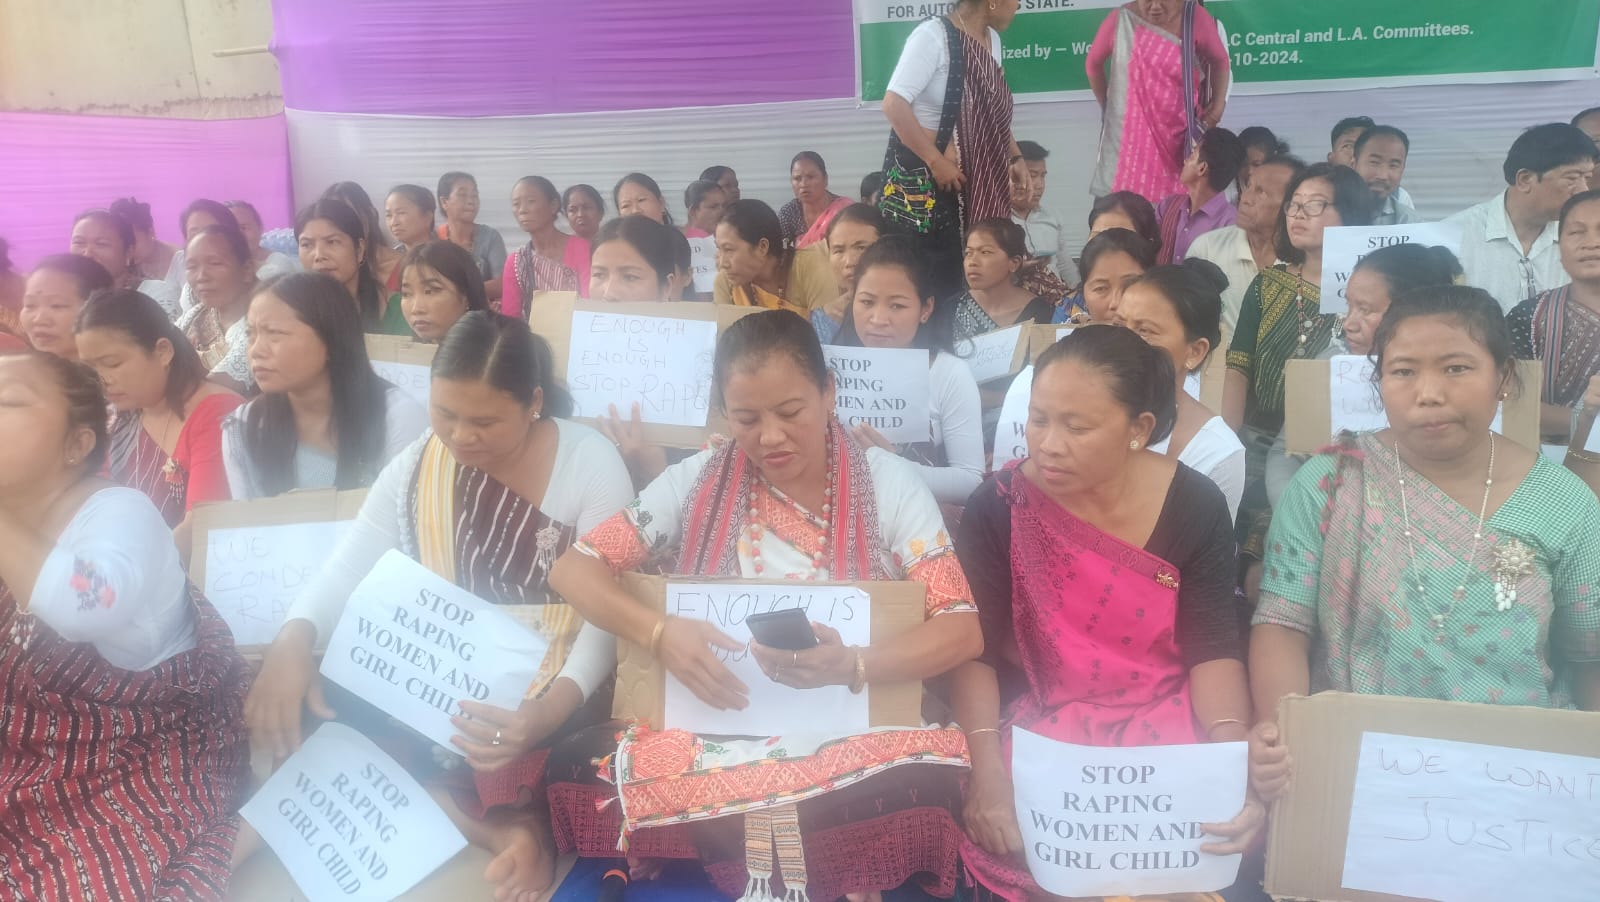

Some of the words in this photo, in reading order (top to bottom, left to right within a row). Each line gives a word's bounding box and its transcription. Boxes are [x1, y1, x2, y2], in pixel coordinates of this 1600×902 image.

[887, 4, 915, 18] FOR
[1245, 29, 1300, 46] Central
[1304, 27, 1333, 43] and
[1337, 26, 1368, 41] L.A.
[1373, 22, 1474, 40] Committees.
[1035, 43, 1051, 60] by
[1367, 235, 1410, 248] STOP
[590, 315, 686, 343] ENOUGH
[627, 336, 649, 352] IS
[582, 350, 666, 369] ENOUGH
[830, 357, 872, 372] STOP
[572, 373, 632, 400] STOP
[870, 398, 907, 411] AND
[849, 415, 904, 429] CHILD
[416, 587, 475, 627] STOP
[828, 595, 856, 622] IS
[392, 606, 476, 661] RAPING
[350, 645, 400, 686] GIRL
[357, 615, 442, 675] WOMEN
[442, 667, 490, 701] AND
[360, 762, 411, 811] STOP
[1081, 764, 1156, 785] STOP
[1379, 747, 1448, 775] WE
[1486, 761, 1600, 800] WANT
[331, 772, 399, 843] RAPING
[1062, 791, 1173, 814] RAPING
[295, 772, 362, 846] WOMEN
[354, 845, 389, 881] AND
[1030, 809, 1139, 842] WOMEN
[278, 797, 320, 847] GIRL
[317, 842, 362, 895] CHILD
[1034, 841, 1102, 870] GIRL
[1110, 850, 1200, 871] CHILD
